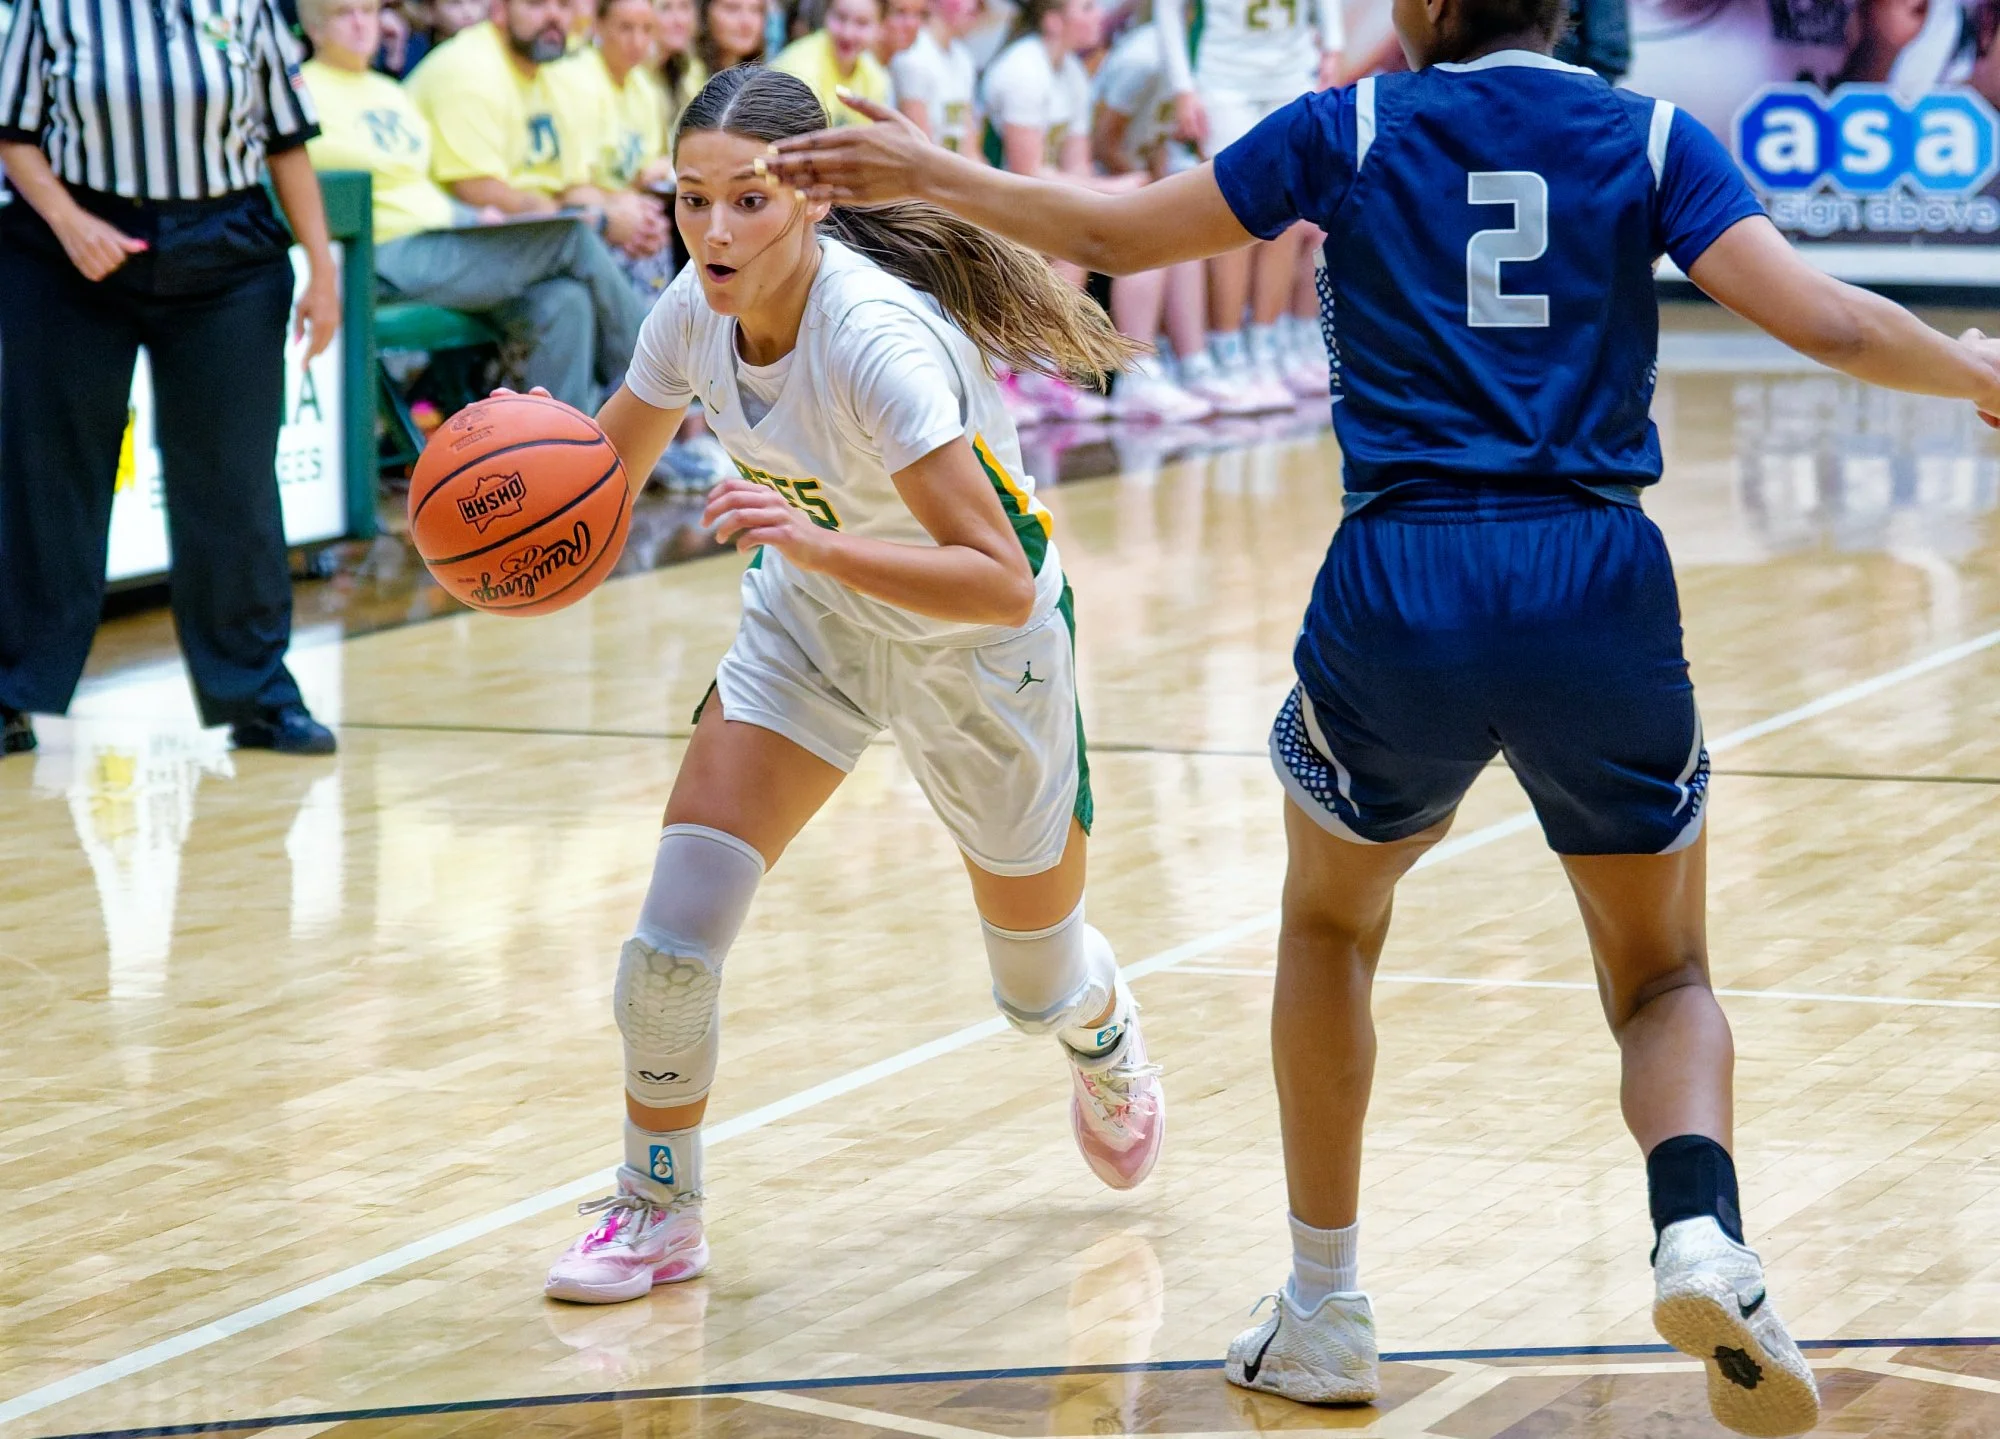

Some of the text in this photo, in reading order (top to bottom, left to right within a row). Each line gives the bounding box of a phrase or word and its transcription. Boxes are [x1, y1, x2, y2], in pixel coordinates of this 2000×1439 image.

[1755, 107, 1978, 175] asa
[1865, 192, 1999, 232] above
[1466, 170, 1550, 328] 2
[461, 477, 523, 519] OHSAA
[471, 520, 591, 603] Rawlings
